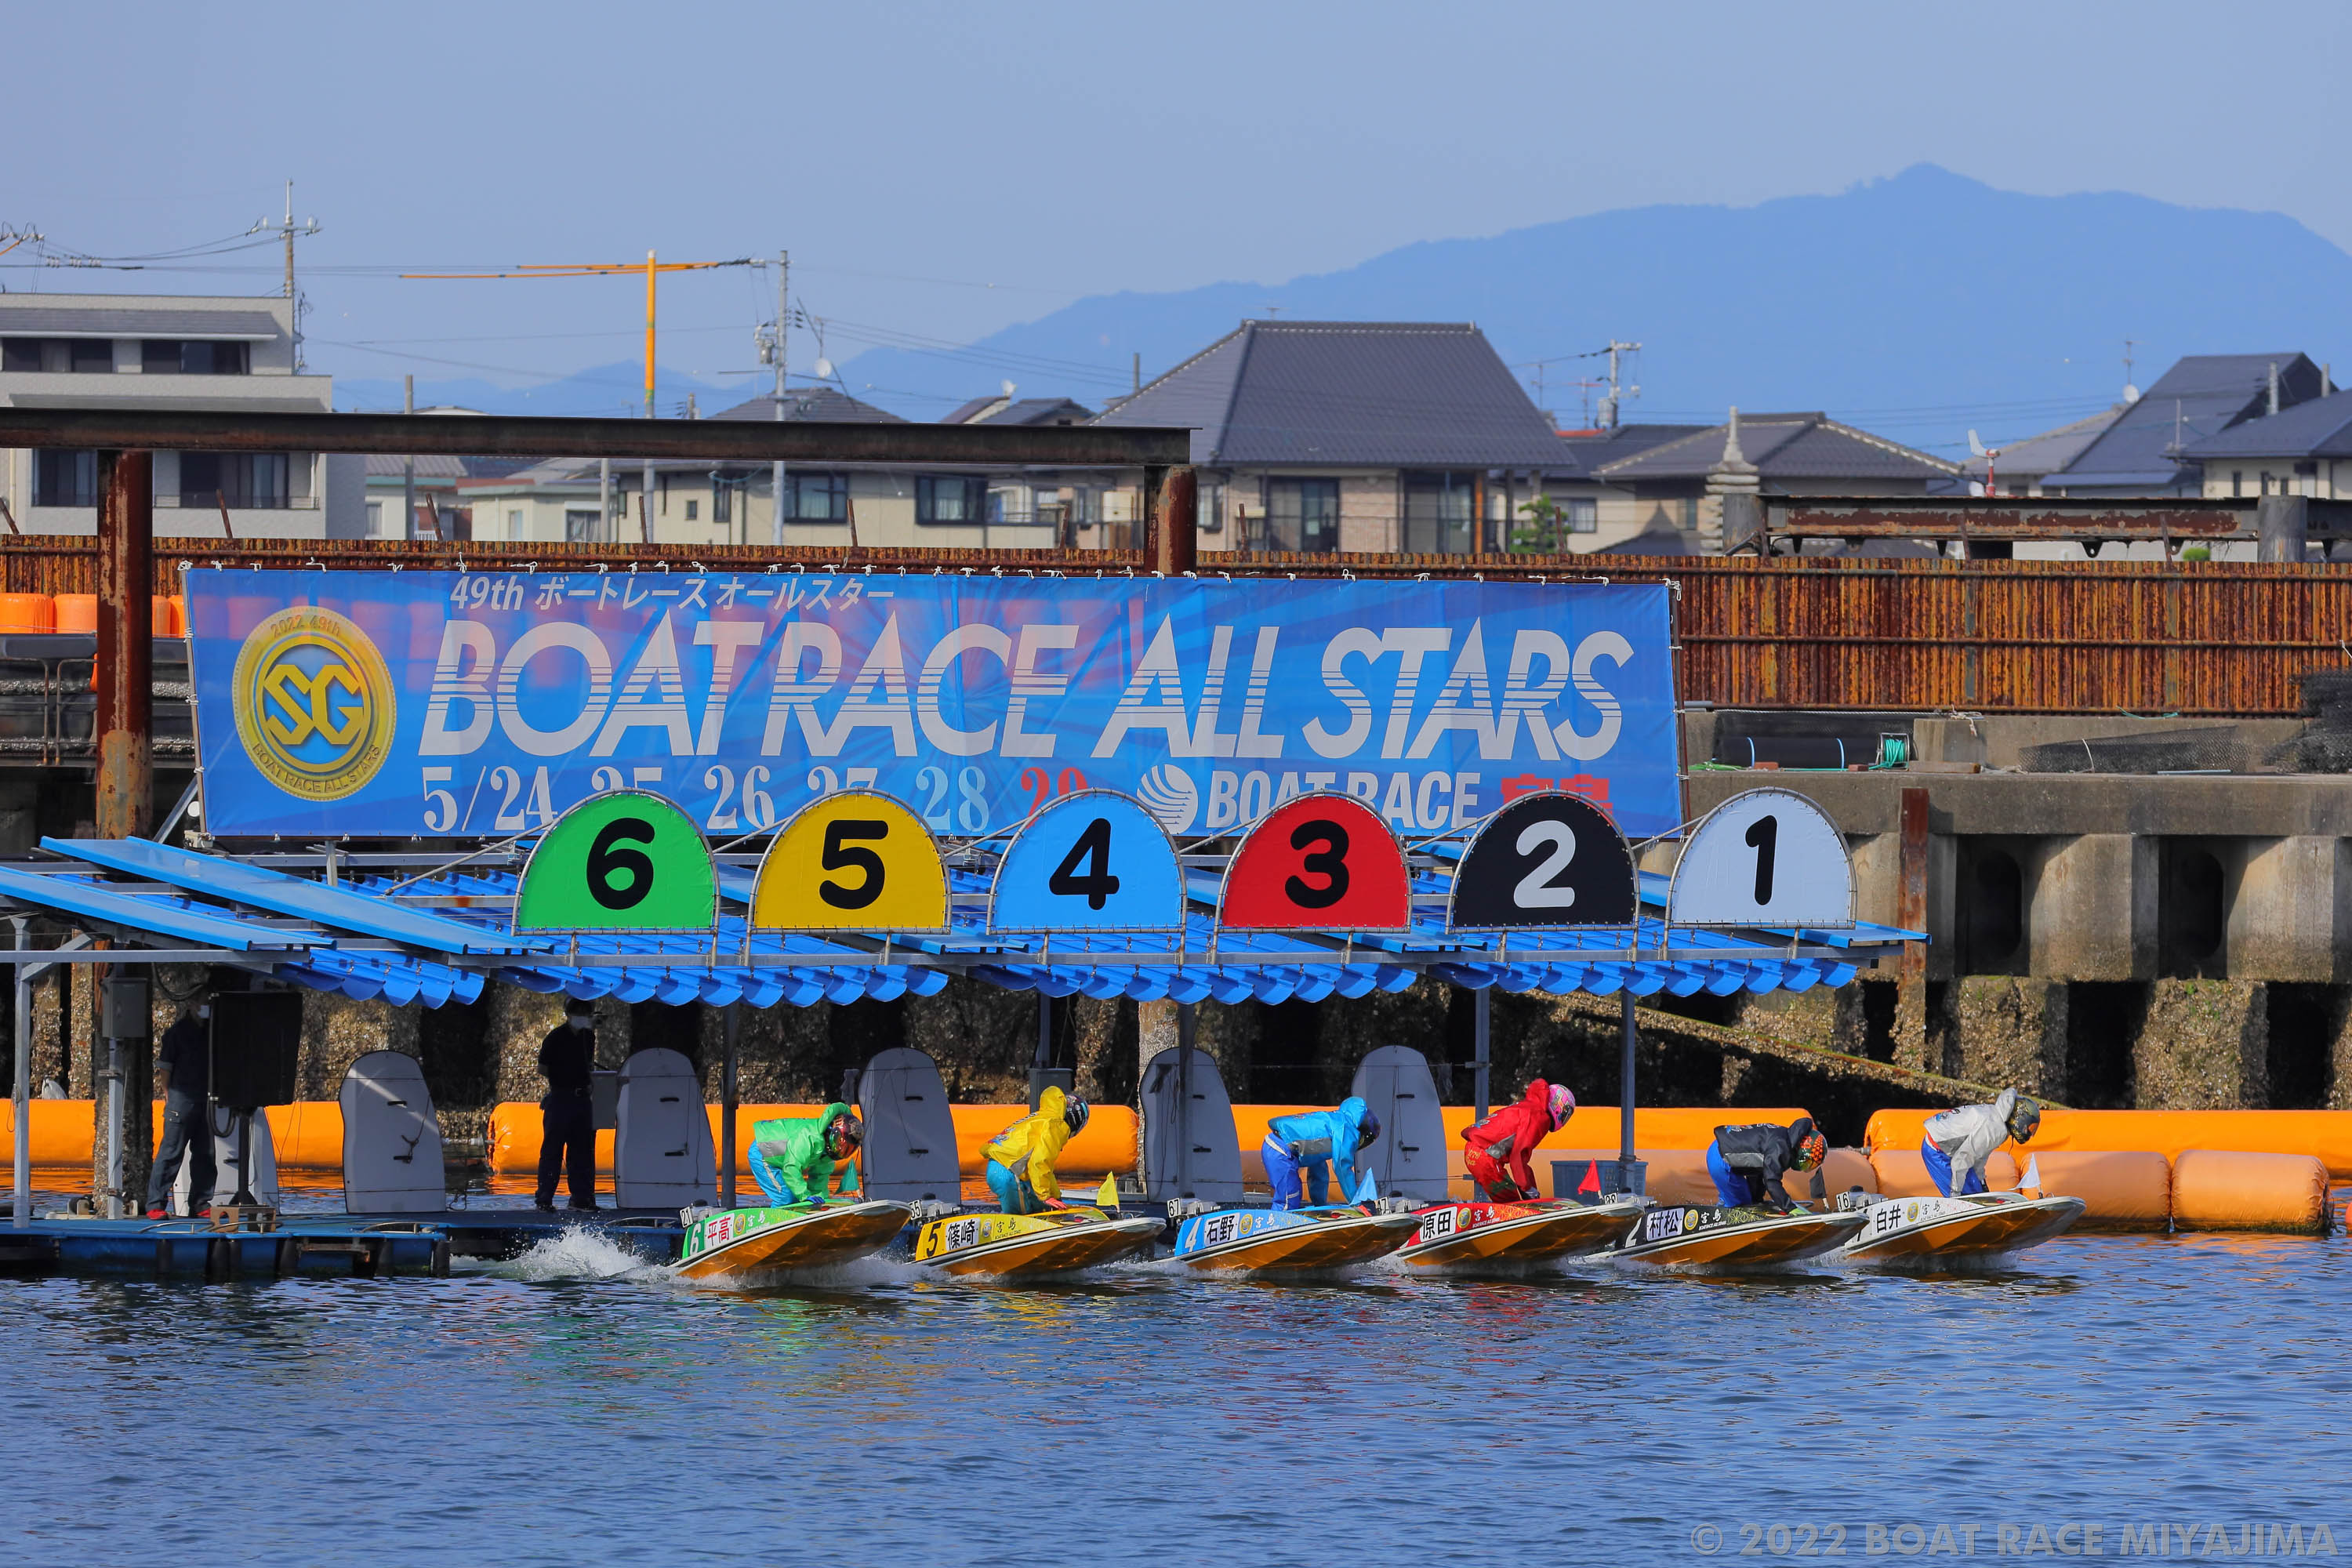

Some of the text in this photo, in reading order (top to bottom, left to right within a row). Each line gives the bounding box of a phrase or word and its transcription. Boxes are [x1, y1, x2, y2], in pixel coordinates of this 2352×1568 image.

[450, 575, 524, 611] 49th
[1091, 612, 1284, 758] ALL
[1302, 616, 1635, 760] STARS
[263, 664, 365, 745] SG
[422, 765, 558, 833] 5/24
[703, 764, 775, 830] 26
[916, 766, 989, 833] 28
[587, 818, 655, 910] 6
[819, 820, 888, 910] 5
[1049, 818, 1120, 910] 4
[1285, 819, 1349, 909] 3
[1513, 820, 1576, 908] 2
[1745, 815, 1777, 906] 1
[681, 1209, 691, 1226] 21
[1168, 1199, 1180, 1216] 67
[1837, 1192, 1849, 1210] 16
[1876, 1203, 1901, 1233] 白井
[690, 1223, 702, 1254] 6
[707, 1216, 731, 1247] 平高
[926, 1221, 942, 1258] 5
[947, 1218, 975, 1250] 篠崎
[1185, 1217, 1203, 1253] 4
[1206, 1214, 1236, 1245] 石野
[1422, 1210, 1452, 1240] 原田
[1649, 1210, 1679, 1239] 村松
